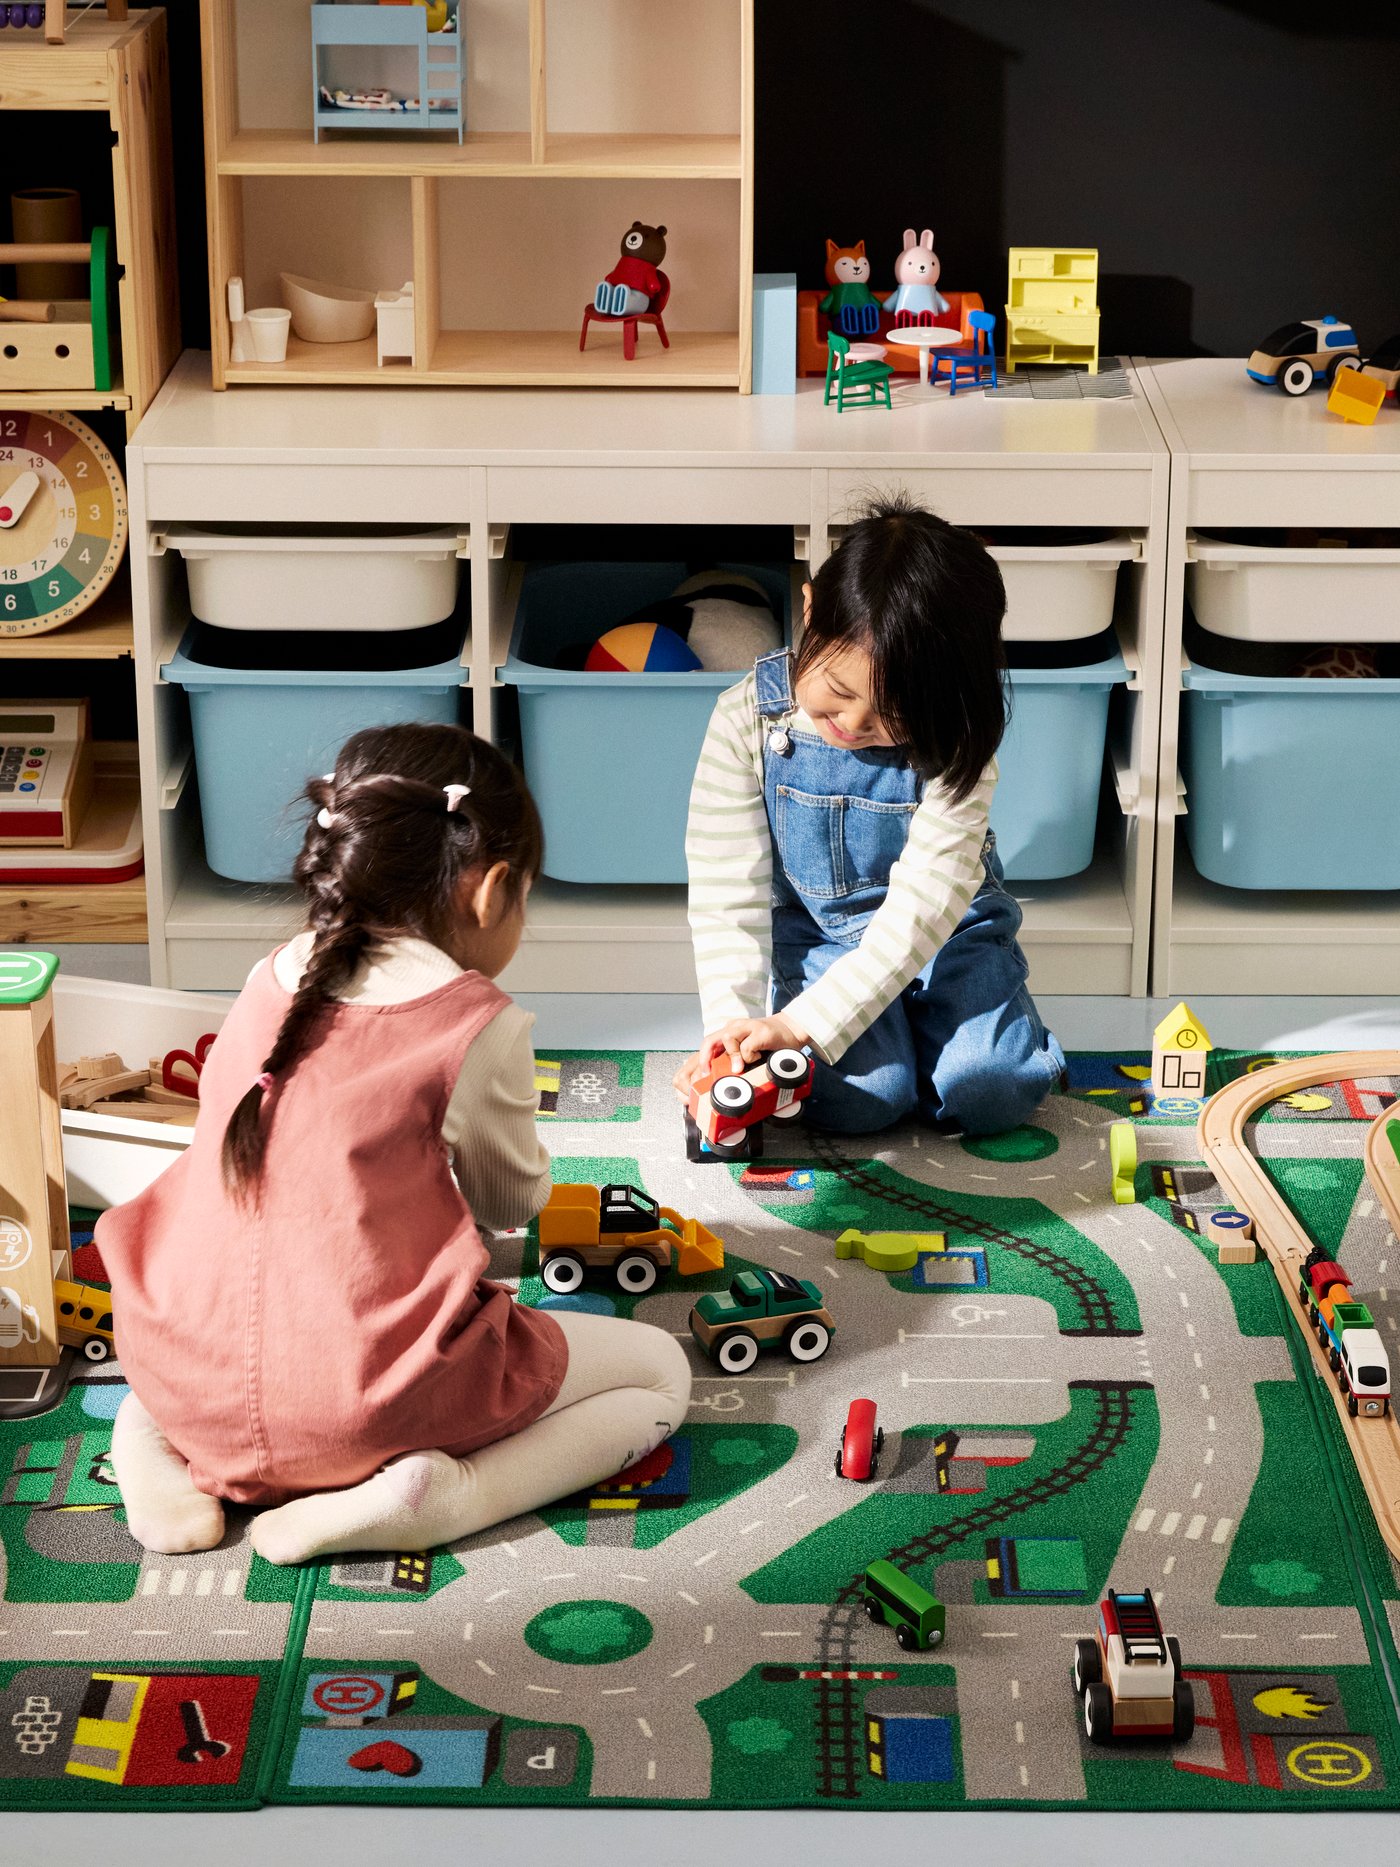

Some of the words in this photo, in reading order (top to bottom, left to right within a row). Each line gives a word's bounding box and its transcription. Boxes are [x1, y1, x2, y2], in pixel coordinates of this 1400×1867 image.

[43, 431, 52, 447] 1
[100, 452, 110, 461] 10
[28, 457, 44, 468] 13
[76, 461, 88, 478] 2
[50, 478, 66, 489] 14
[60, 507, 76, 518] 15
[89, 505, 101, 521] 3
[117, 508, 127, 517] 15
[52, 537, 68, 548] 16
[78, 548, 91, 564] 4
[31, 560, 47, 571] 17
[103, 565, 114, 573] 20
[1, 569, 18, 580] 18
[48, 580, 60, 597] 5
[4, 594, 17, 611] 6
[6, 625, 17, 633] 30
[327, 1686, 368, 1704] H
[527, 1746, 555, 1770] P
[1305, 1754, 1352, 1774] H
